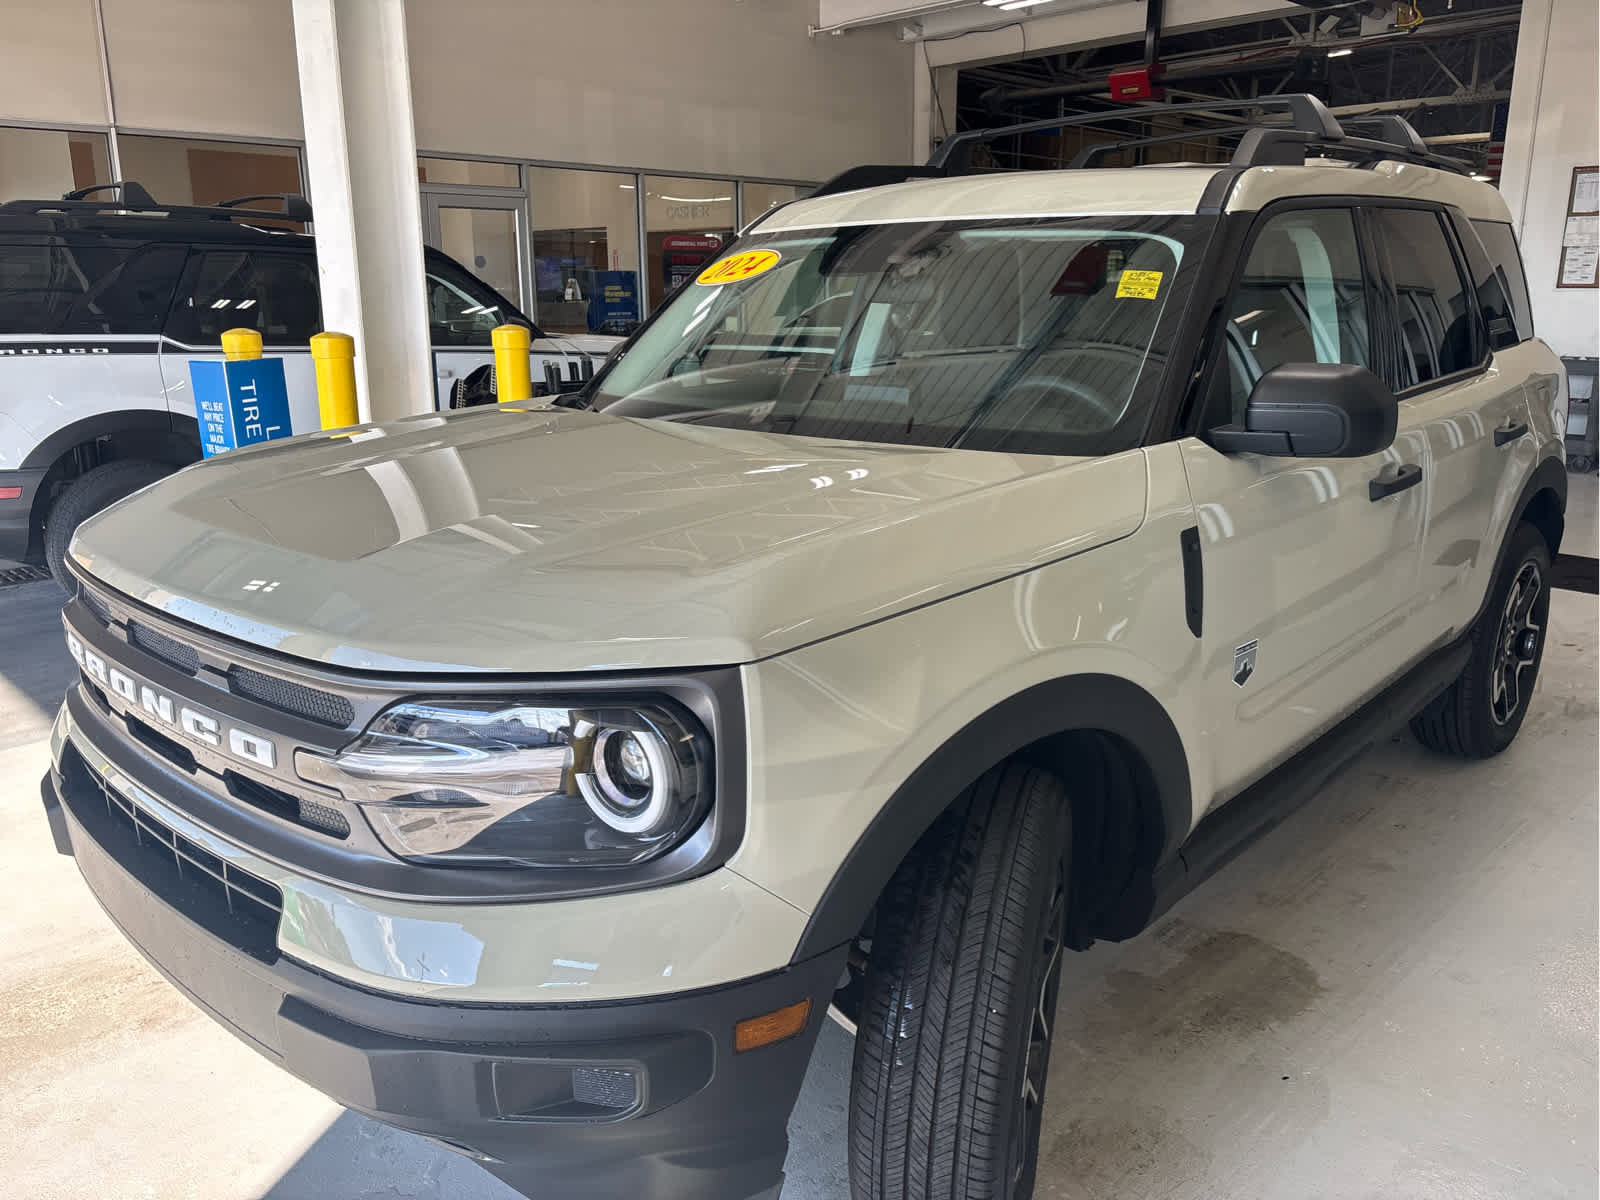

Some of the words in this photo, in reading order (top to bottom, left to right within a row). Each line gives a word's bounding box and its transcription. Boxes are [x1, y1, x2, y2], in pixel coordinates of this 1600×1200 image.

[701, 255, 774, 281] 2024
[240, 378, 262, 439] TIRE
[67, 631, 277, 769] BRONCO
